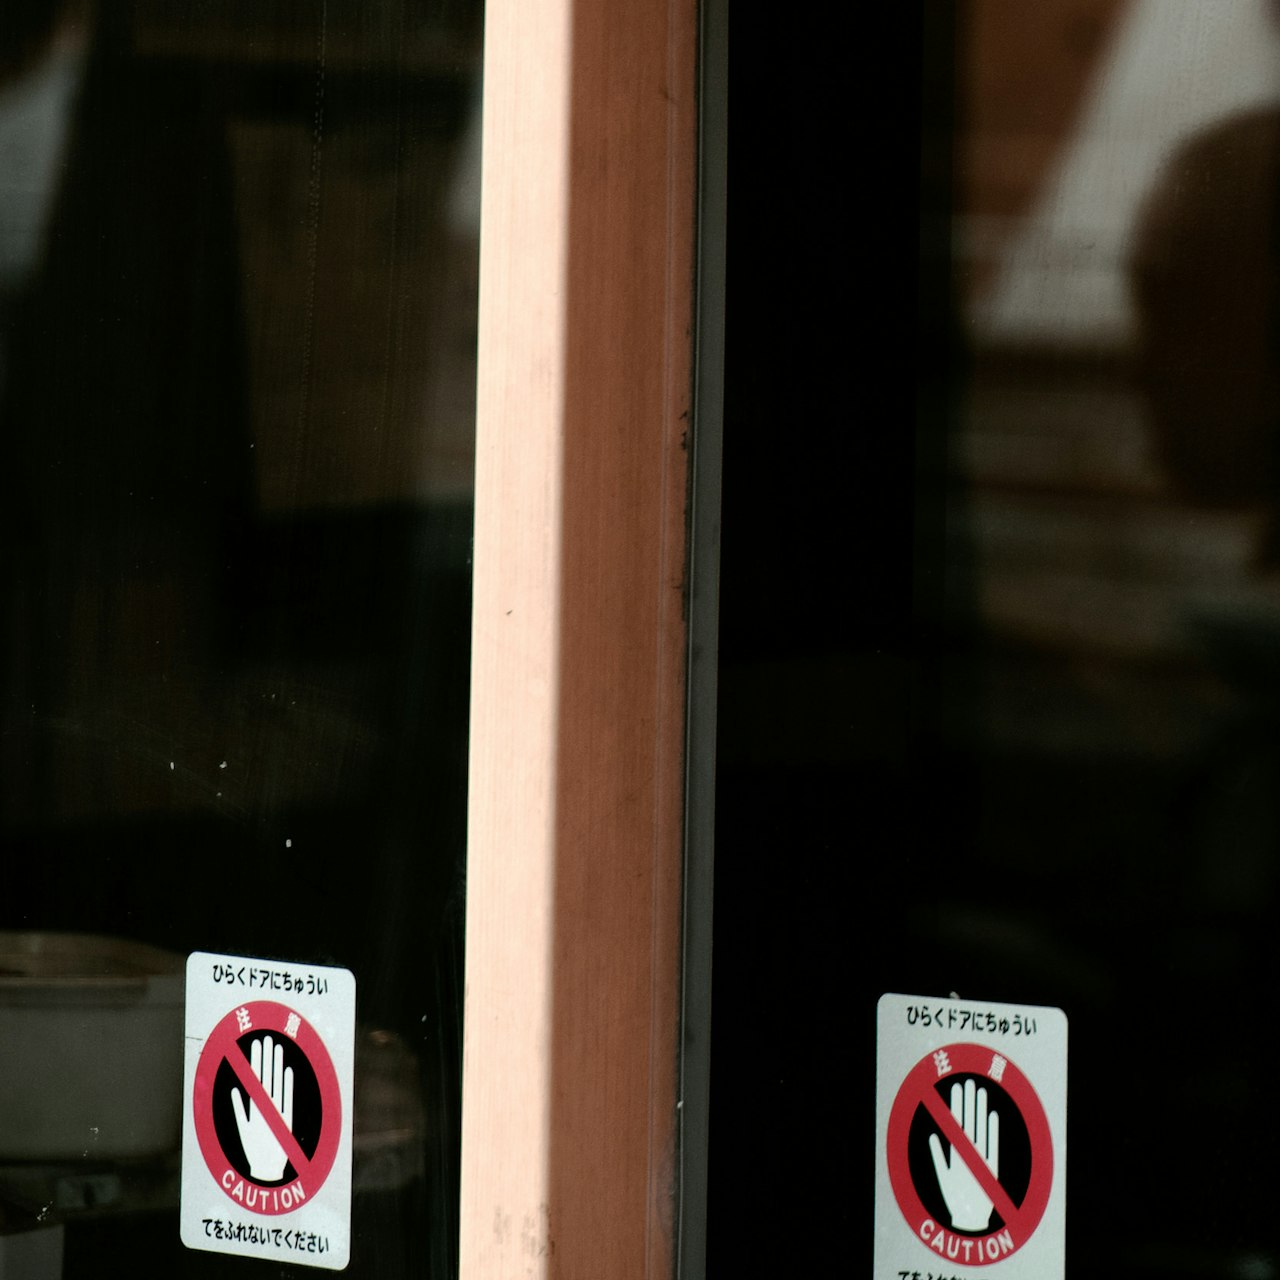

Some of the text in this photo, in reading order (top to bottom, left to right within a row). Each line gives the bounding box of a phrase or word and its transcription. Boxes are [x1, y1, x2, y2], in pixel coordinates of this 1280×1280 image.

[212, 964, 329, 996] ひらくドアにちゅうい
[235, 1007, 303, 1039] 注 意
[907, 1005, 1038, 1037] ひらくドアにちゅうい
[932, 1049, 1008, 1083] 注 意
[221, 1169, 306, 1212] CAUTION
[202, 1217, 330, 1254] てをふれないでください
[919, 1218, 1015, 1263] CAUTION
